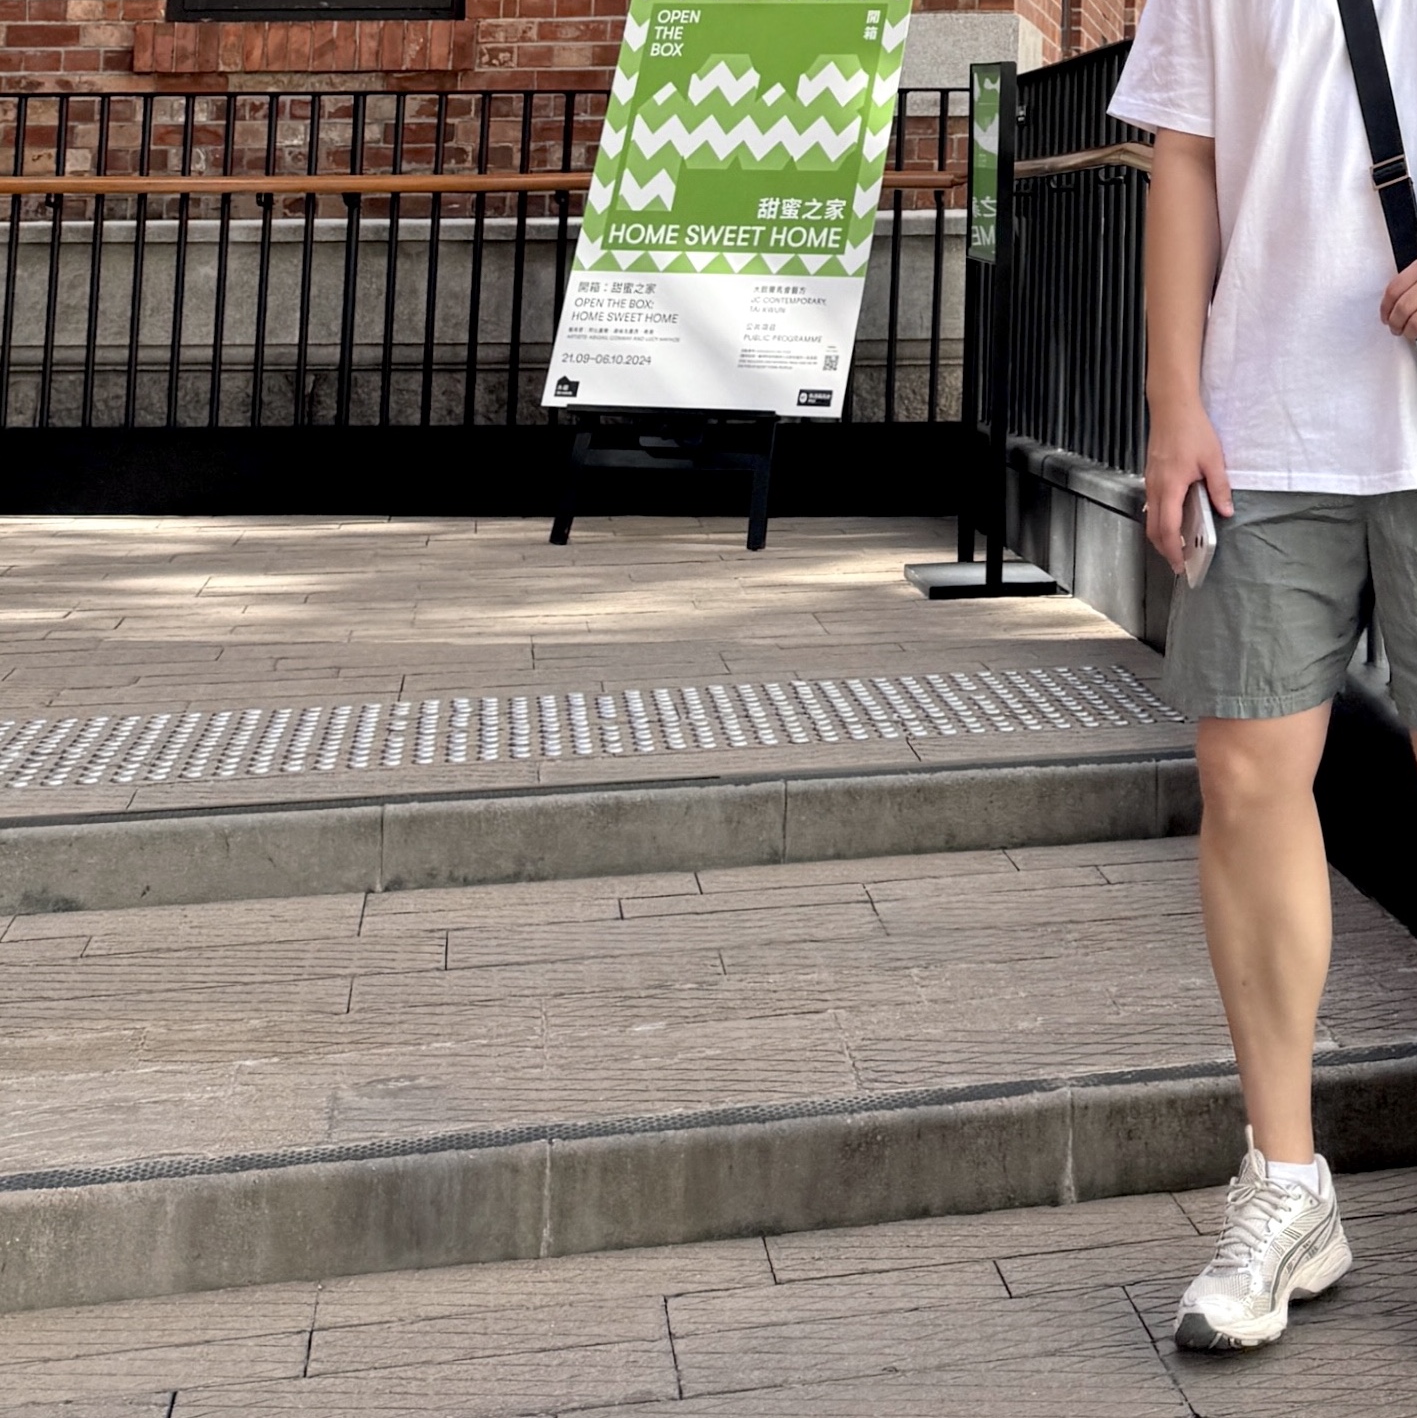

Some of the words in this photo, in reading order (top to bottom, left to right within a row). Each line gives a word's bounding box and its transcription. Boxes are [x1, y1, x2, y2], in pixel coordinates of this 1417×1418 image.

[657, 10, 701, 24] OPEN
[654, 26, 684, 40] THE
[650, 43, 684, 57] BOX
[757, 197, 846, 220] 甜蜜之家
[608, 223, 679, 245] HOME
[685, 225, 765, 247] SWEET
[769, 226, 842, 249] HOME
[574, 298, 605, 309] OPEN
[606, 298, 627, 309] THE
[628, 298, 655, 310] BOX:
[571, 311, 604, 323] HOME
[606, 312, 643, 324] SWEET
[644, 312, 679, 325] HOME
[743, 334, 770, 342] PUBLIC
[772, 335, 823, 343] PROGRAMME
